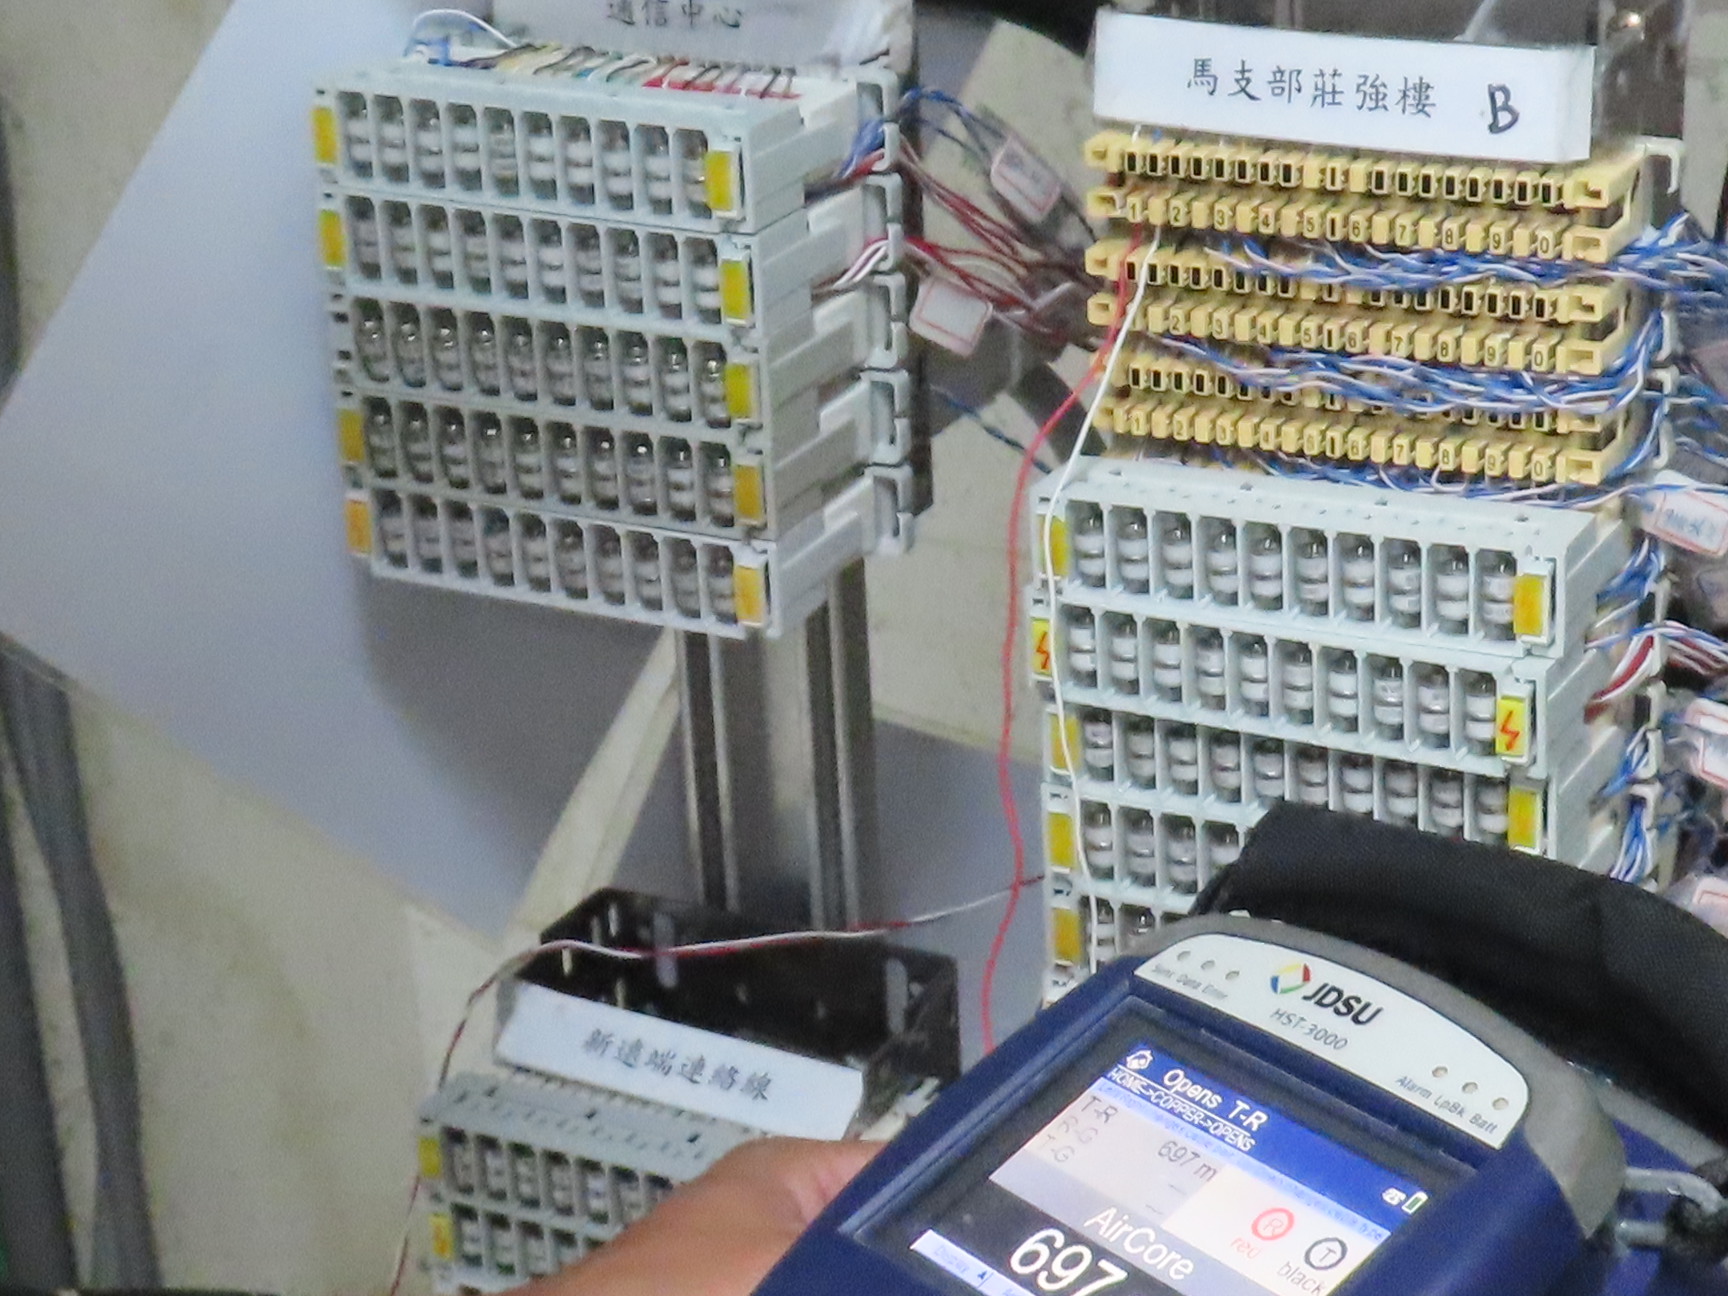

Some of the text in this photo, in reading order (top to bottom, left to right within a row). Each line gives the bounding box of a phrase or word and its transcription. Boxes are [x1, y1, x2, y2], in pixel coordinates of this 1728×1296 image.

[1186, 57, 1520, 134] 馬支部莊強樓 B
[1270, 1007, 1349, 1051] HST-3000
[1302, 982, 1384, 1025] JDSU
[1106, 1066, 1256, 1152] HOME->COPPER->OPENS
[1162, 1068, 1222, 1109] Opens
[1227, 1099, 1269, 1132] T-R
[1395, 1075, 1498, 1134] Alarm LpBk Batt
[1080, 1095, 1119, 1124] T-R
[1158, 1140, 1201, 1167] 697
[1193, 1162, 1218, 1182] m
[1083, 1205, 1195, 1281] AirCore
